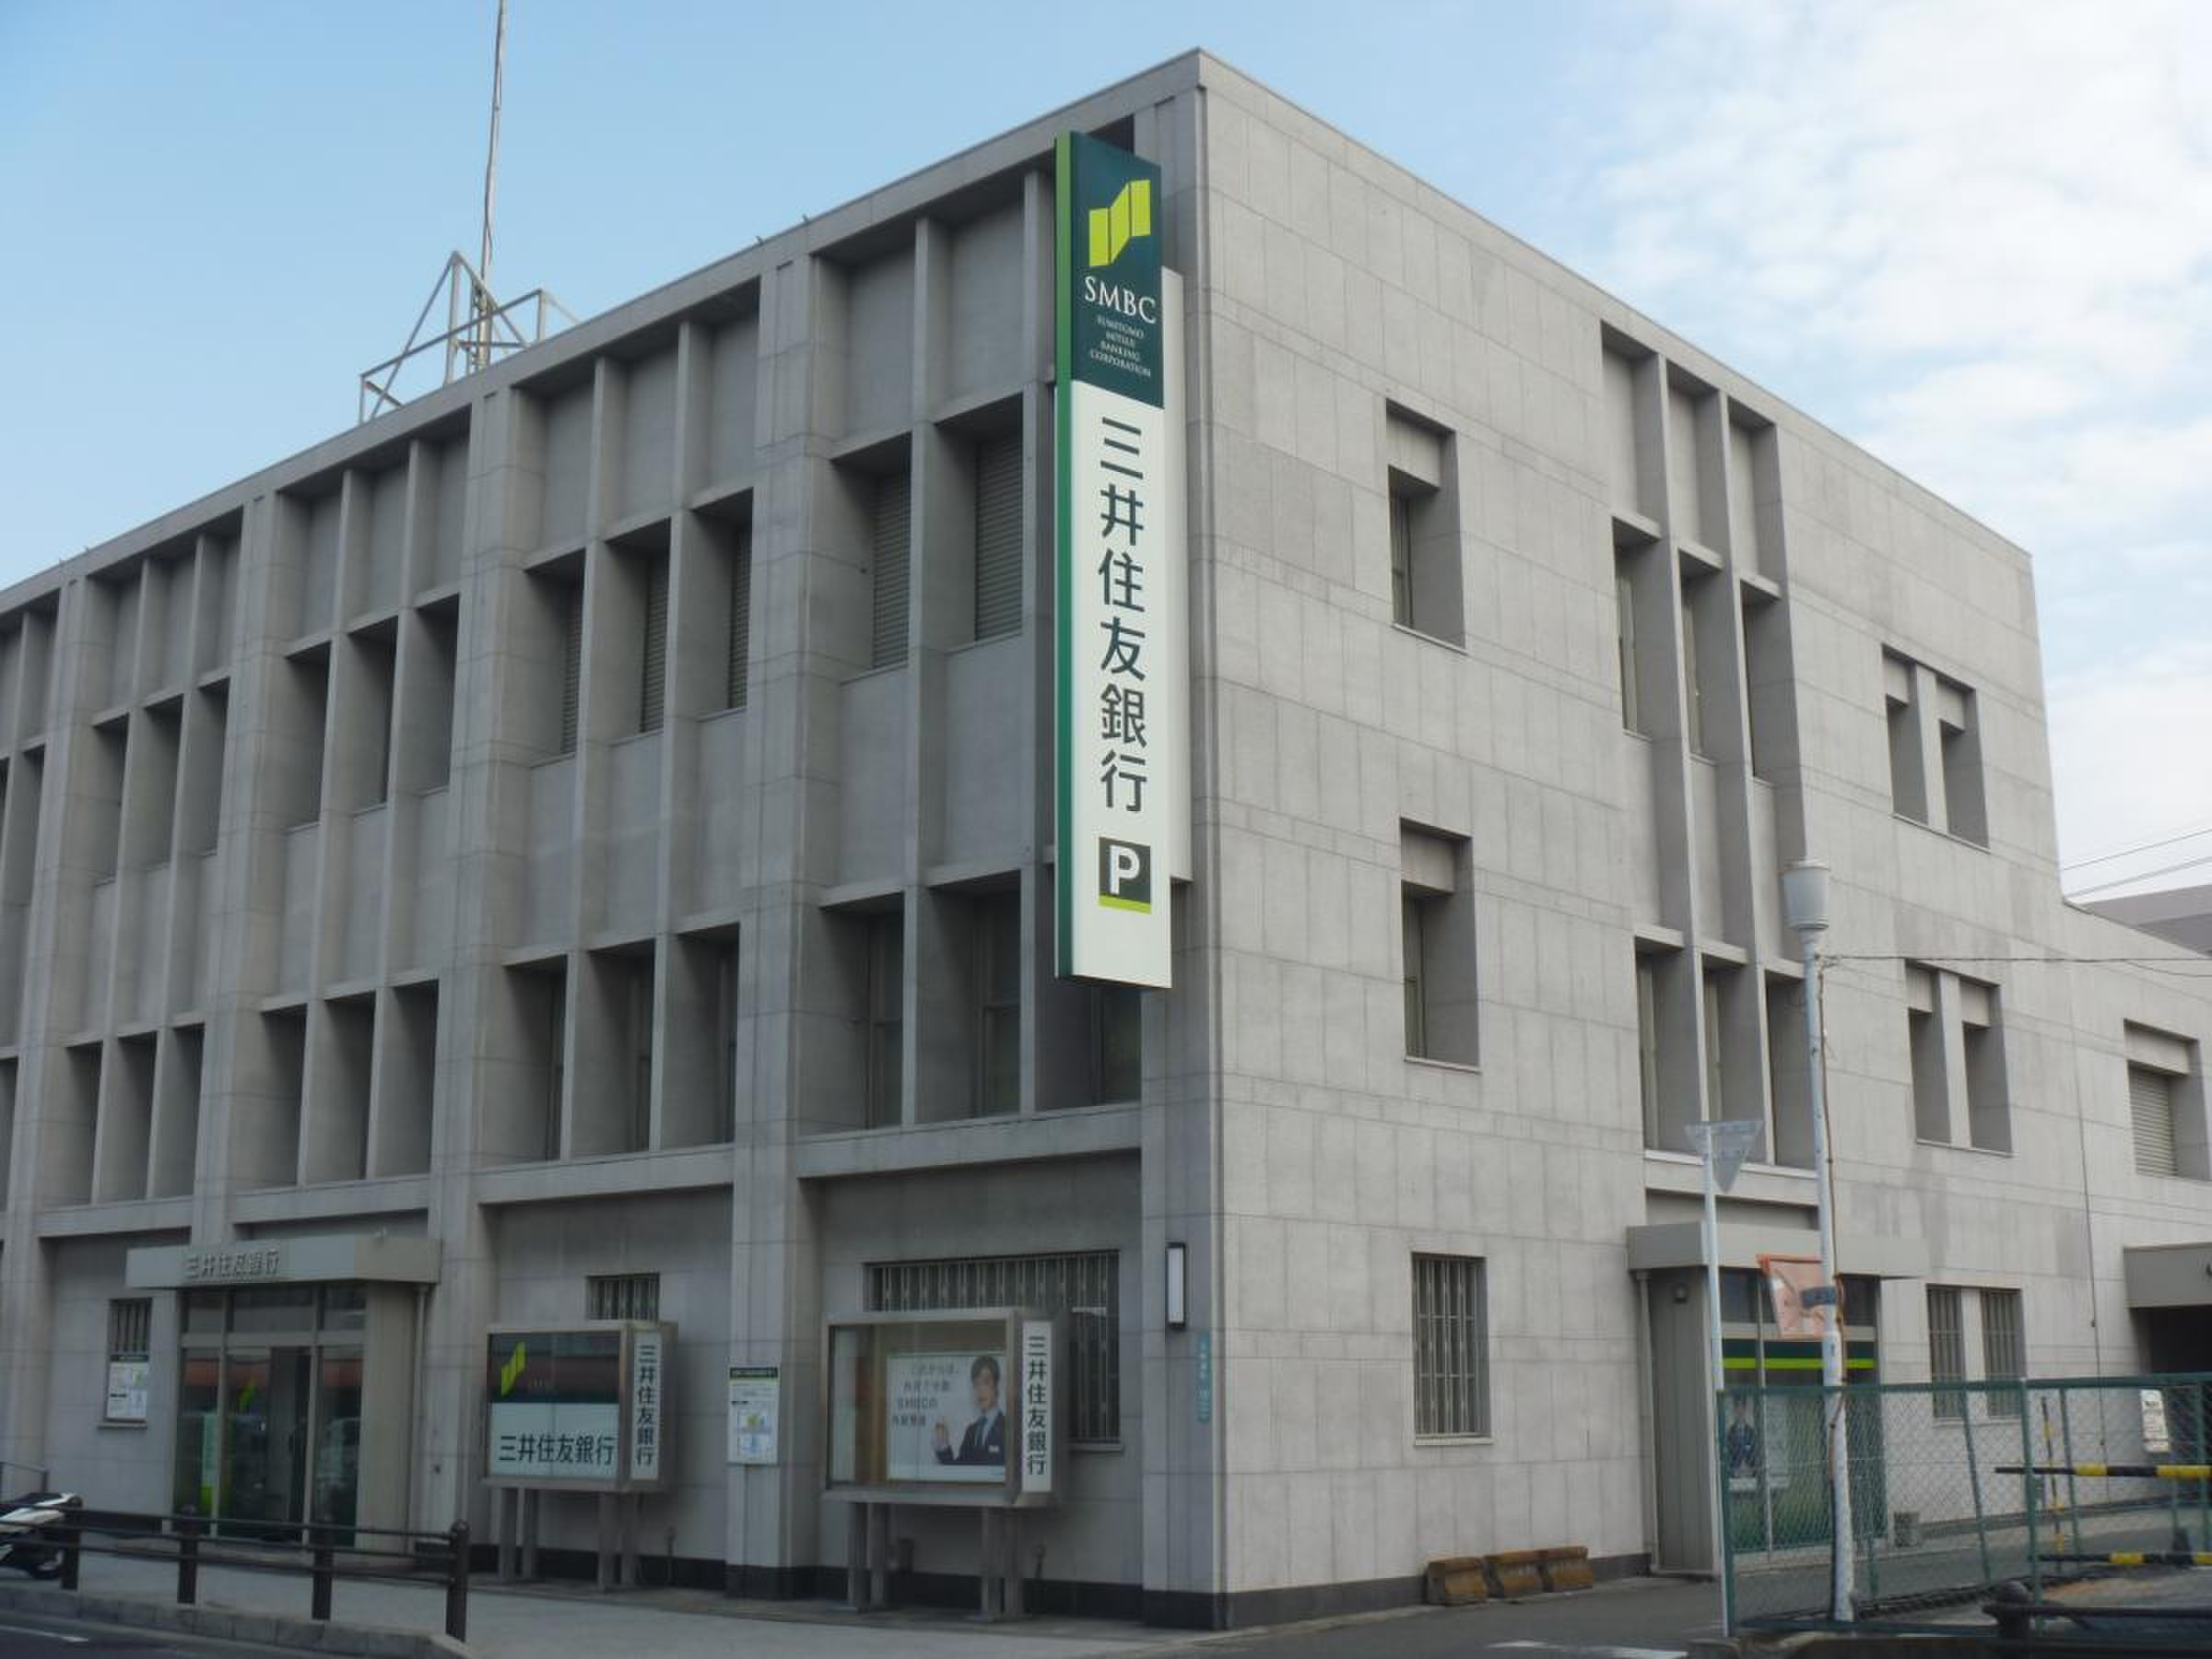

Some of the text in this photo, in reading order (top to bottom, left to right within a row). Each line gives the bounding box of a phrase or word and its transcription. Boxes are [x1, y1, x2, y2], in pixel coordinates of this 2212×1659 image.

[1085, 276, 1157, 324] SMBC
[1098, 416, 1147, 813] 三井住友銀行
[1109, 844, 1140, 896] P
[638, 1344, 658, 1465] 三井住友銀行
[1027, 1335, 1048, 1475] 三井住友銀行
[499, 1433, 616, 1465] 三井住友銀行
